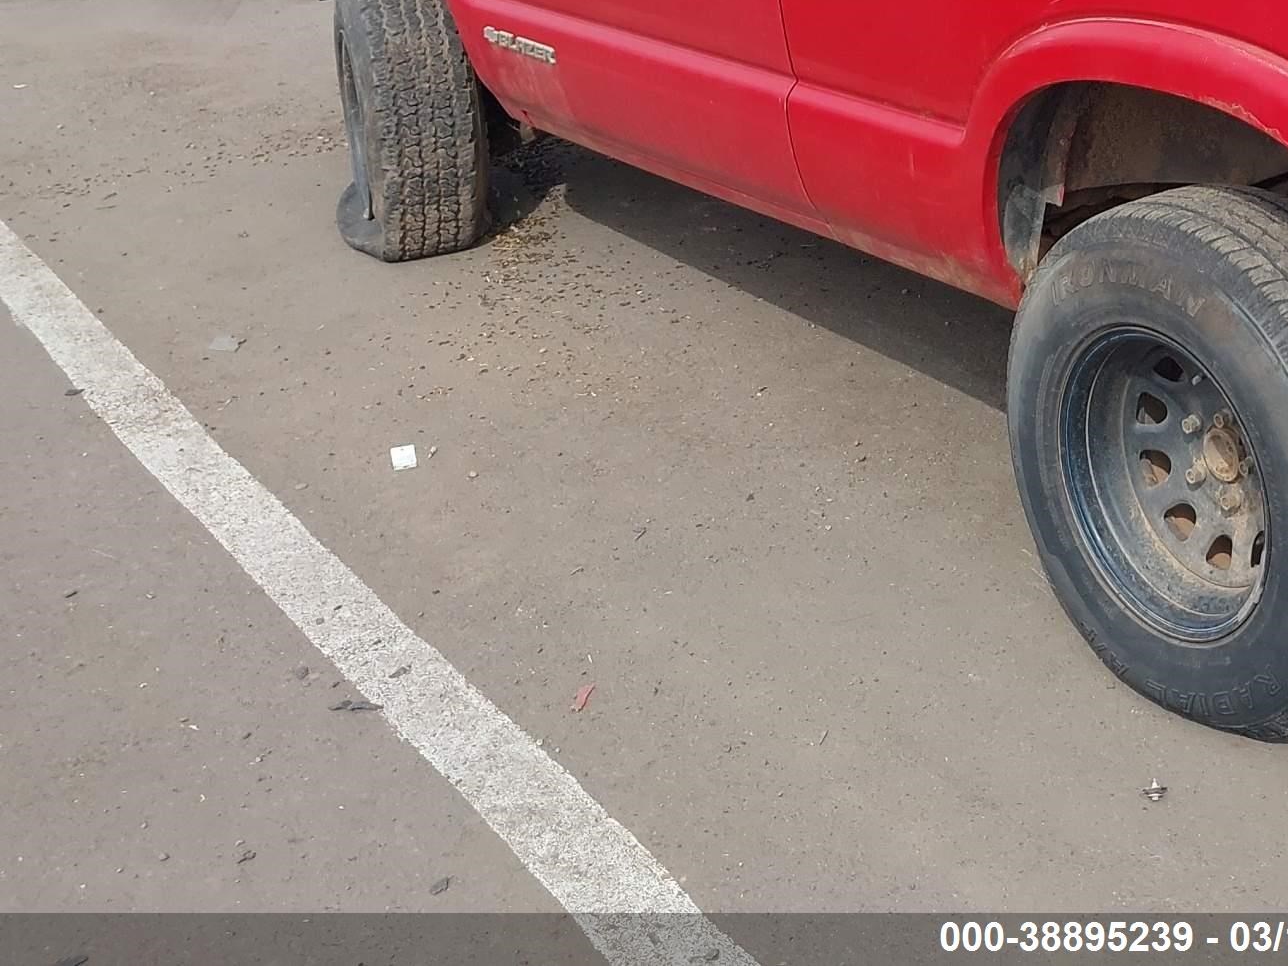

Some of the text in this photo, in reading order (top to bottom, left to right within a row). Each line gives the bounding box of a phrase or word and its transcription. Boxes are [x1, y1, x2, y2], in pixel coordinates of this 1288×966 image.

[496, 29, 557, 65] BLAZER
[1051, 257, 1206, 318] IRONMAN
[1144, 664, 1282, 716] RADIAL
